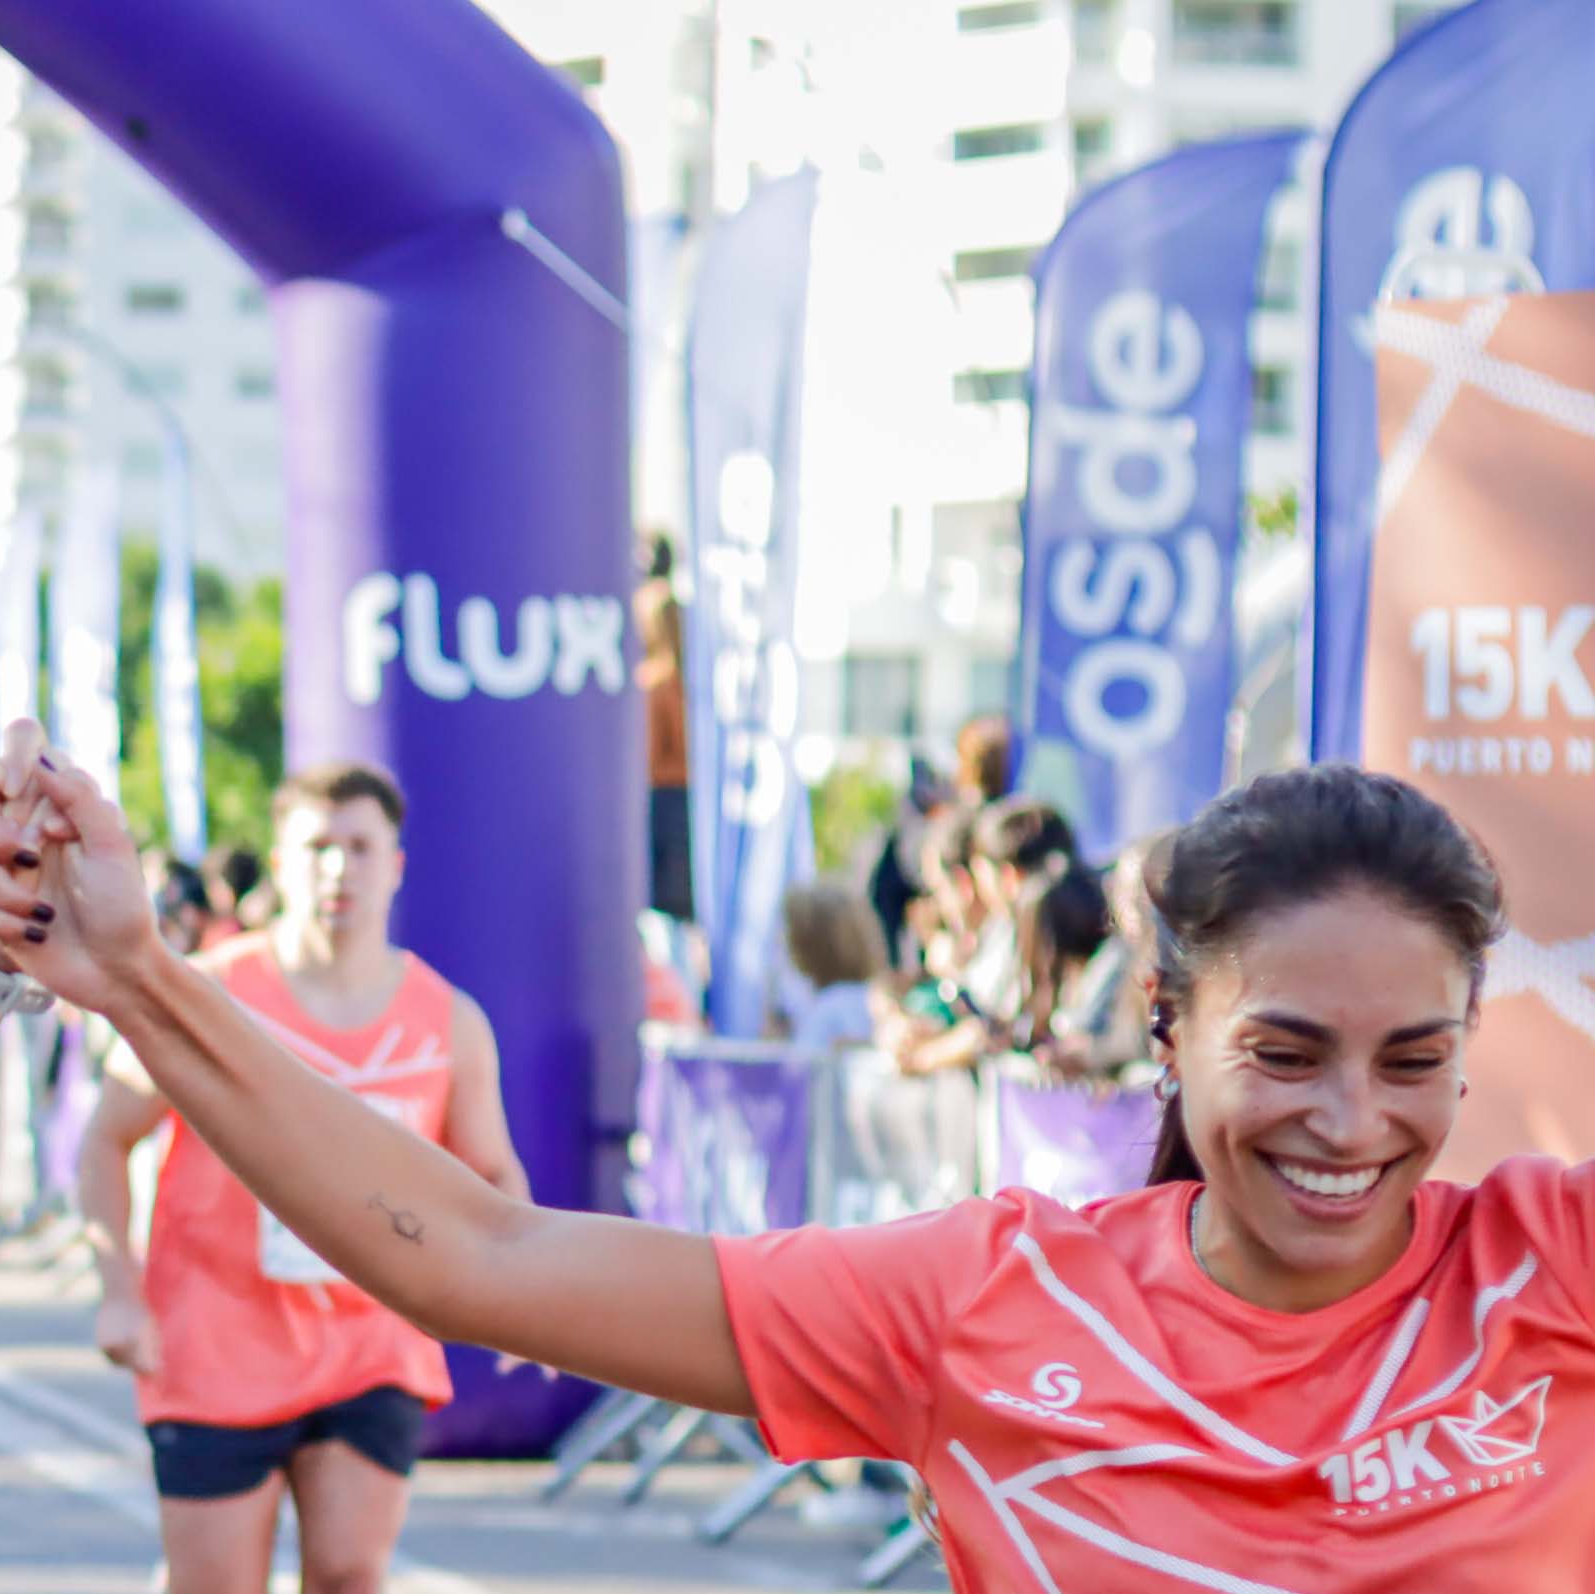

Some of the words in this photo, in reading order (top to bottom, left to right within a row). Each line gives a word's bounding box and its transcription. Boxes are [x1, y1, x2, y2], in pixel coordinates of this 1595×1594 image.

[1047, 290, 1221, 760] osde
[1409, 605, 1595, 722] 15K
[1410, 735, 1552, 776] PUERTO
[1319, 1418, 1451, 1504] 15K
